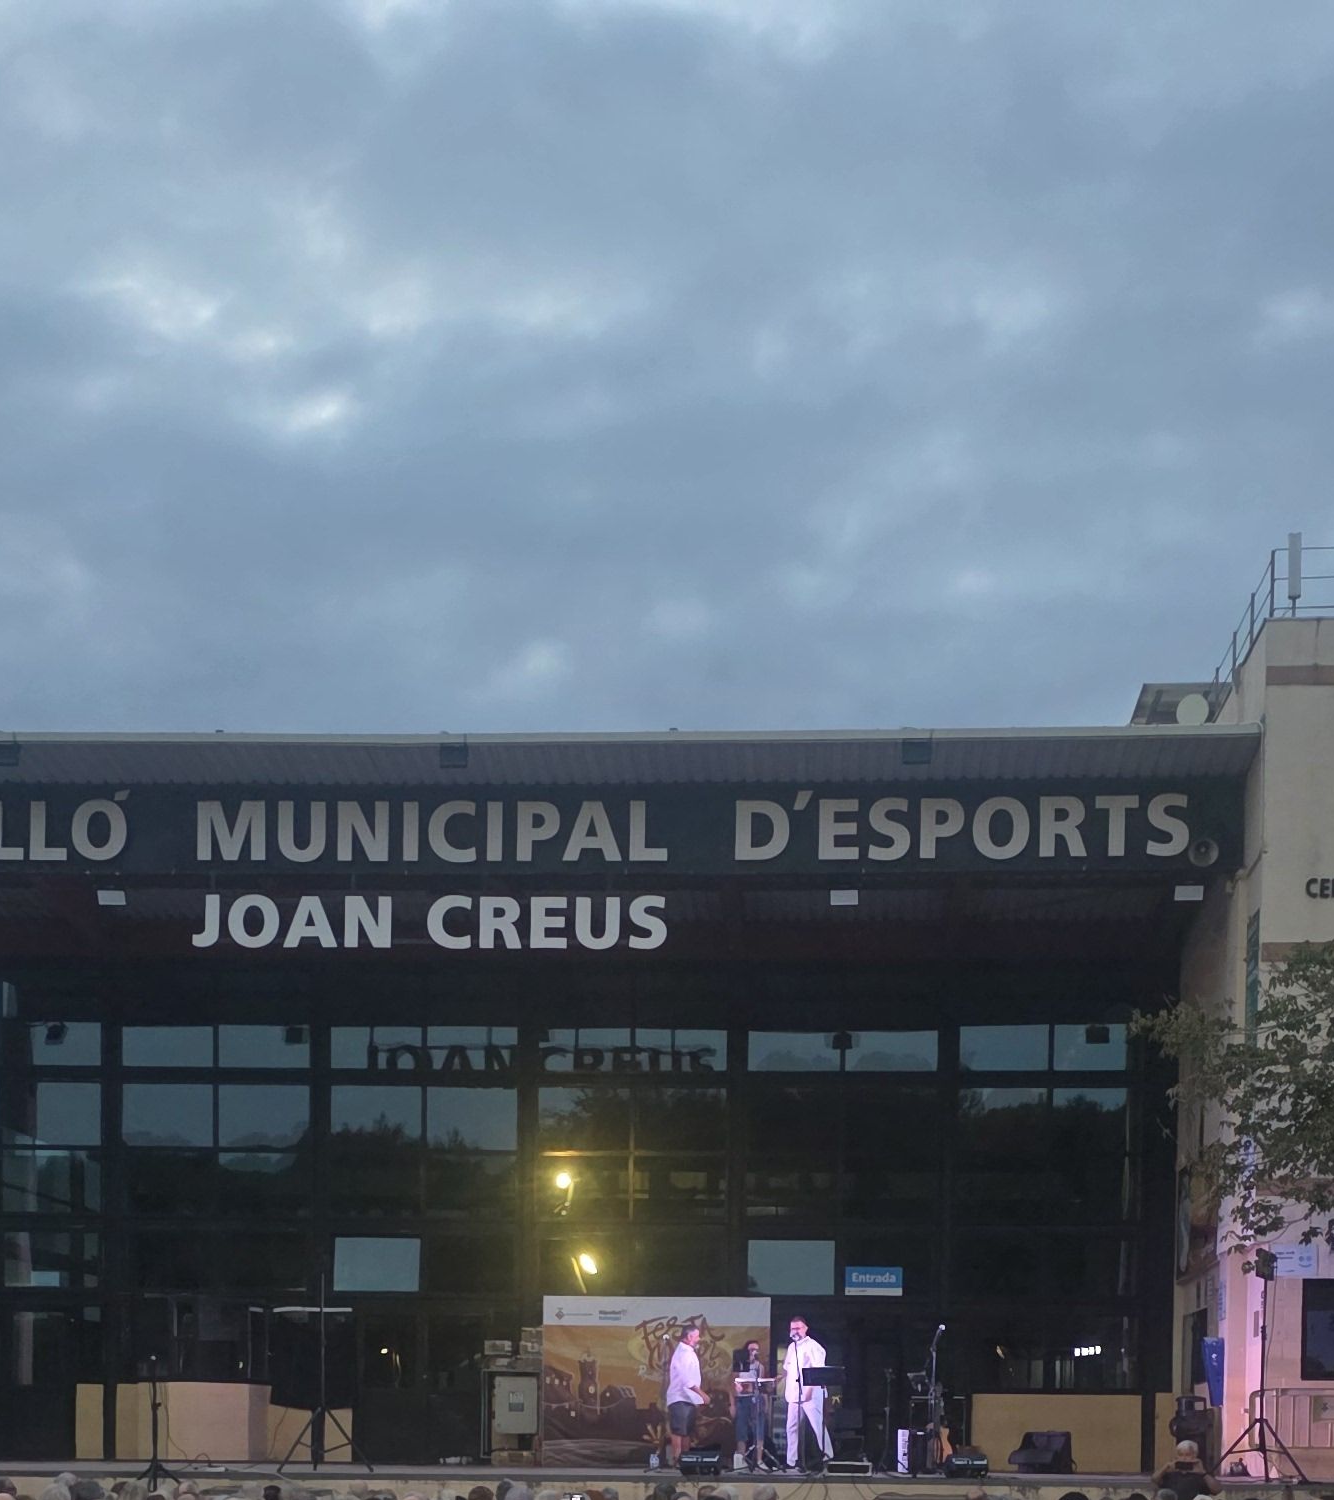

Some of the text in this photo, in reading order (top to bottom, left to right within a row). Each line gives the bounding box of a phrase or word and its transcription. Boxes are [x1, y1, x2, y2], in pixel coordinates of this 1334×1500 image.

[195, 799, 668, 864] MUNICIPAL
[733, 789, 1190, 861] D'ESPORTS
[191, 893, 668, 950] JOAN CREUS
[851, 1271, 897, 1284] Entrada
